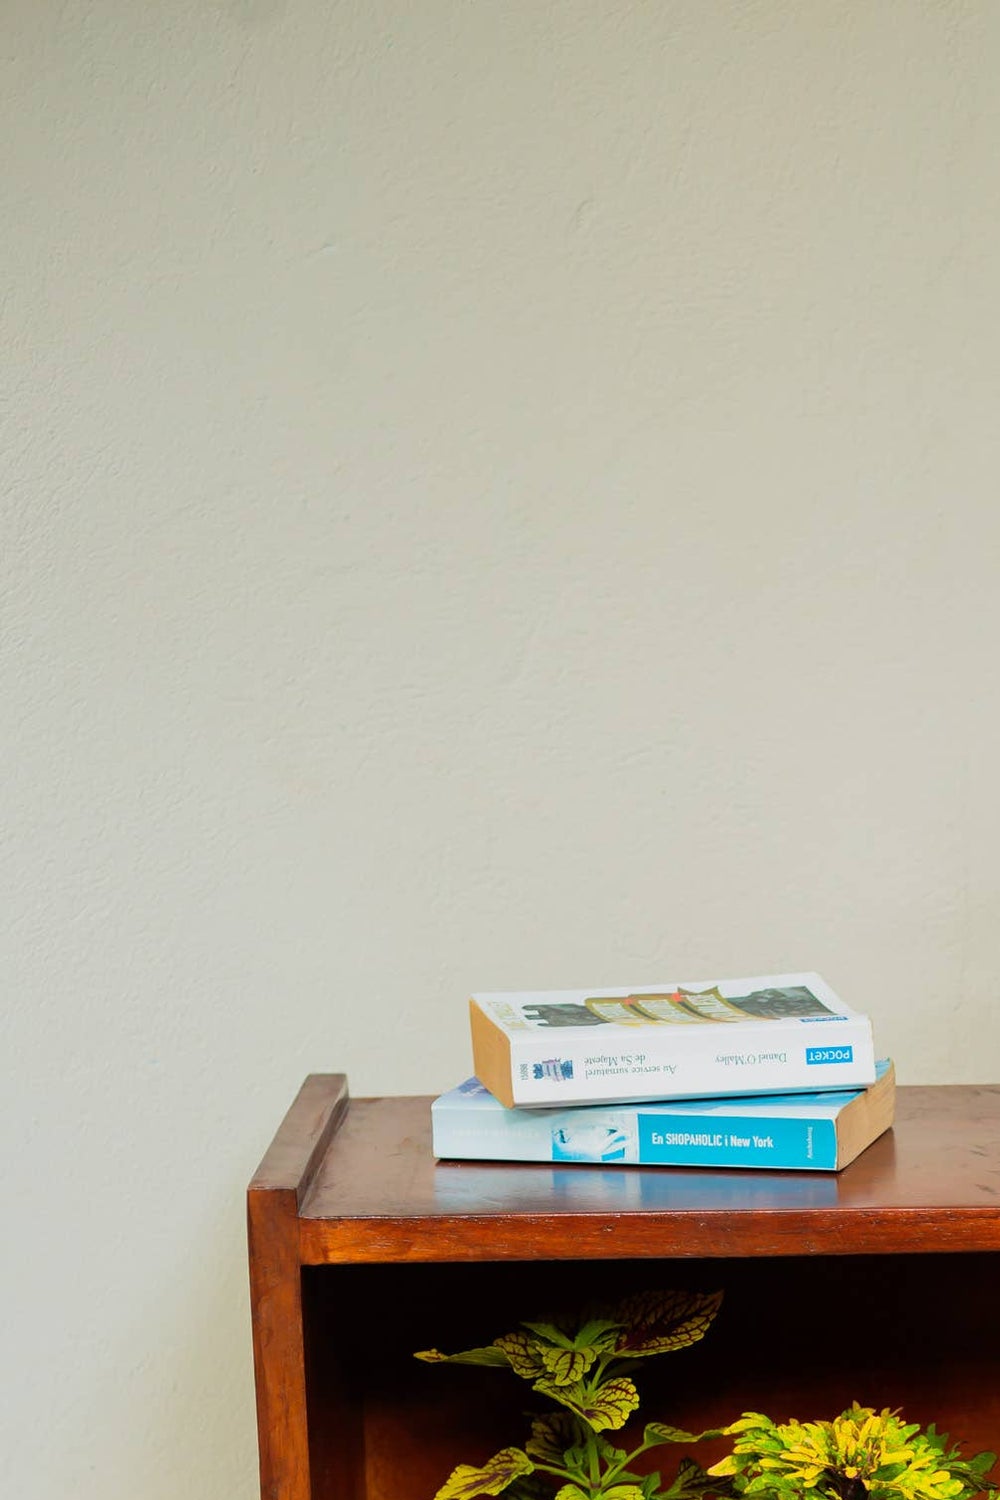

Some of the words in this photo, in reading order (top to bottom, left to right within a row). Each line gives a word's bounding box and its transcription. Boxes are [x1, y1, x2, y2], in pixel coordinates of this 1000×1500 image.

[620, 1055, 632, 1065] Sa
[635, 1055, 646, 1064] de
[715, 1054, 756, 1066] O'Malley
[758, 1052, 787, 1063] Daniel
[585, 1066, 629, 1079] surnaturel
[631, 1066, 661, 1074] service
[663, 1064, 677, 1075] Au
[651, 1132, 664, 1145] En
[665, 1133, 723, 1147] SHOPAHOLIC
[724, 1135, 729, 1147] i
[730, 1136, 751, 1148] New
[752, 1136, 774, 1149] York
